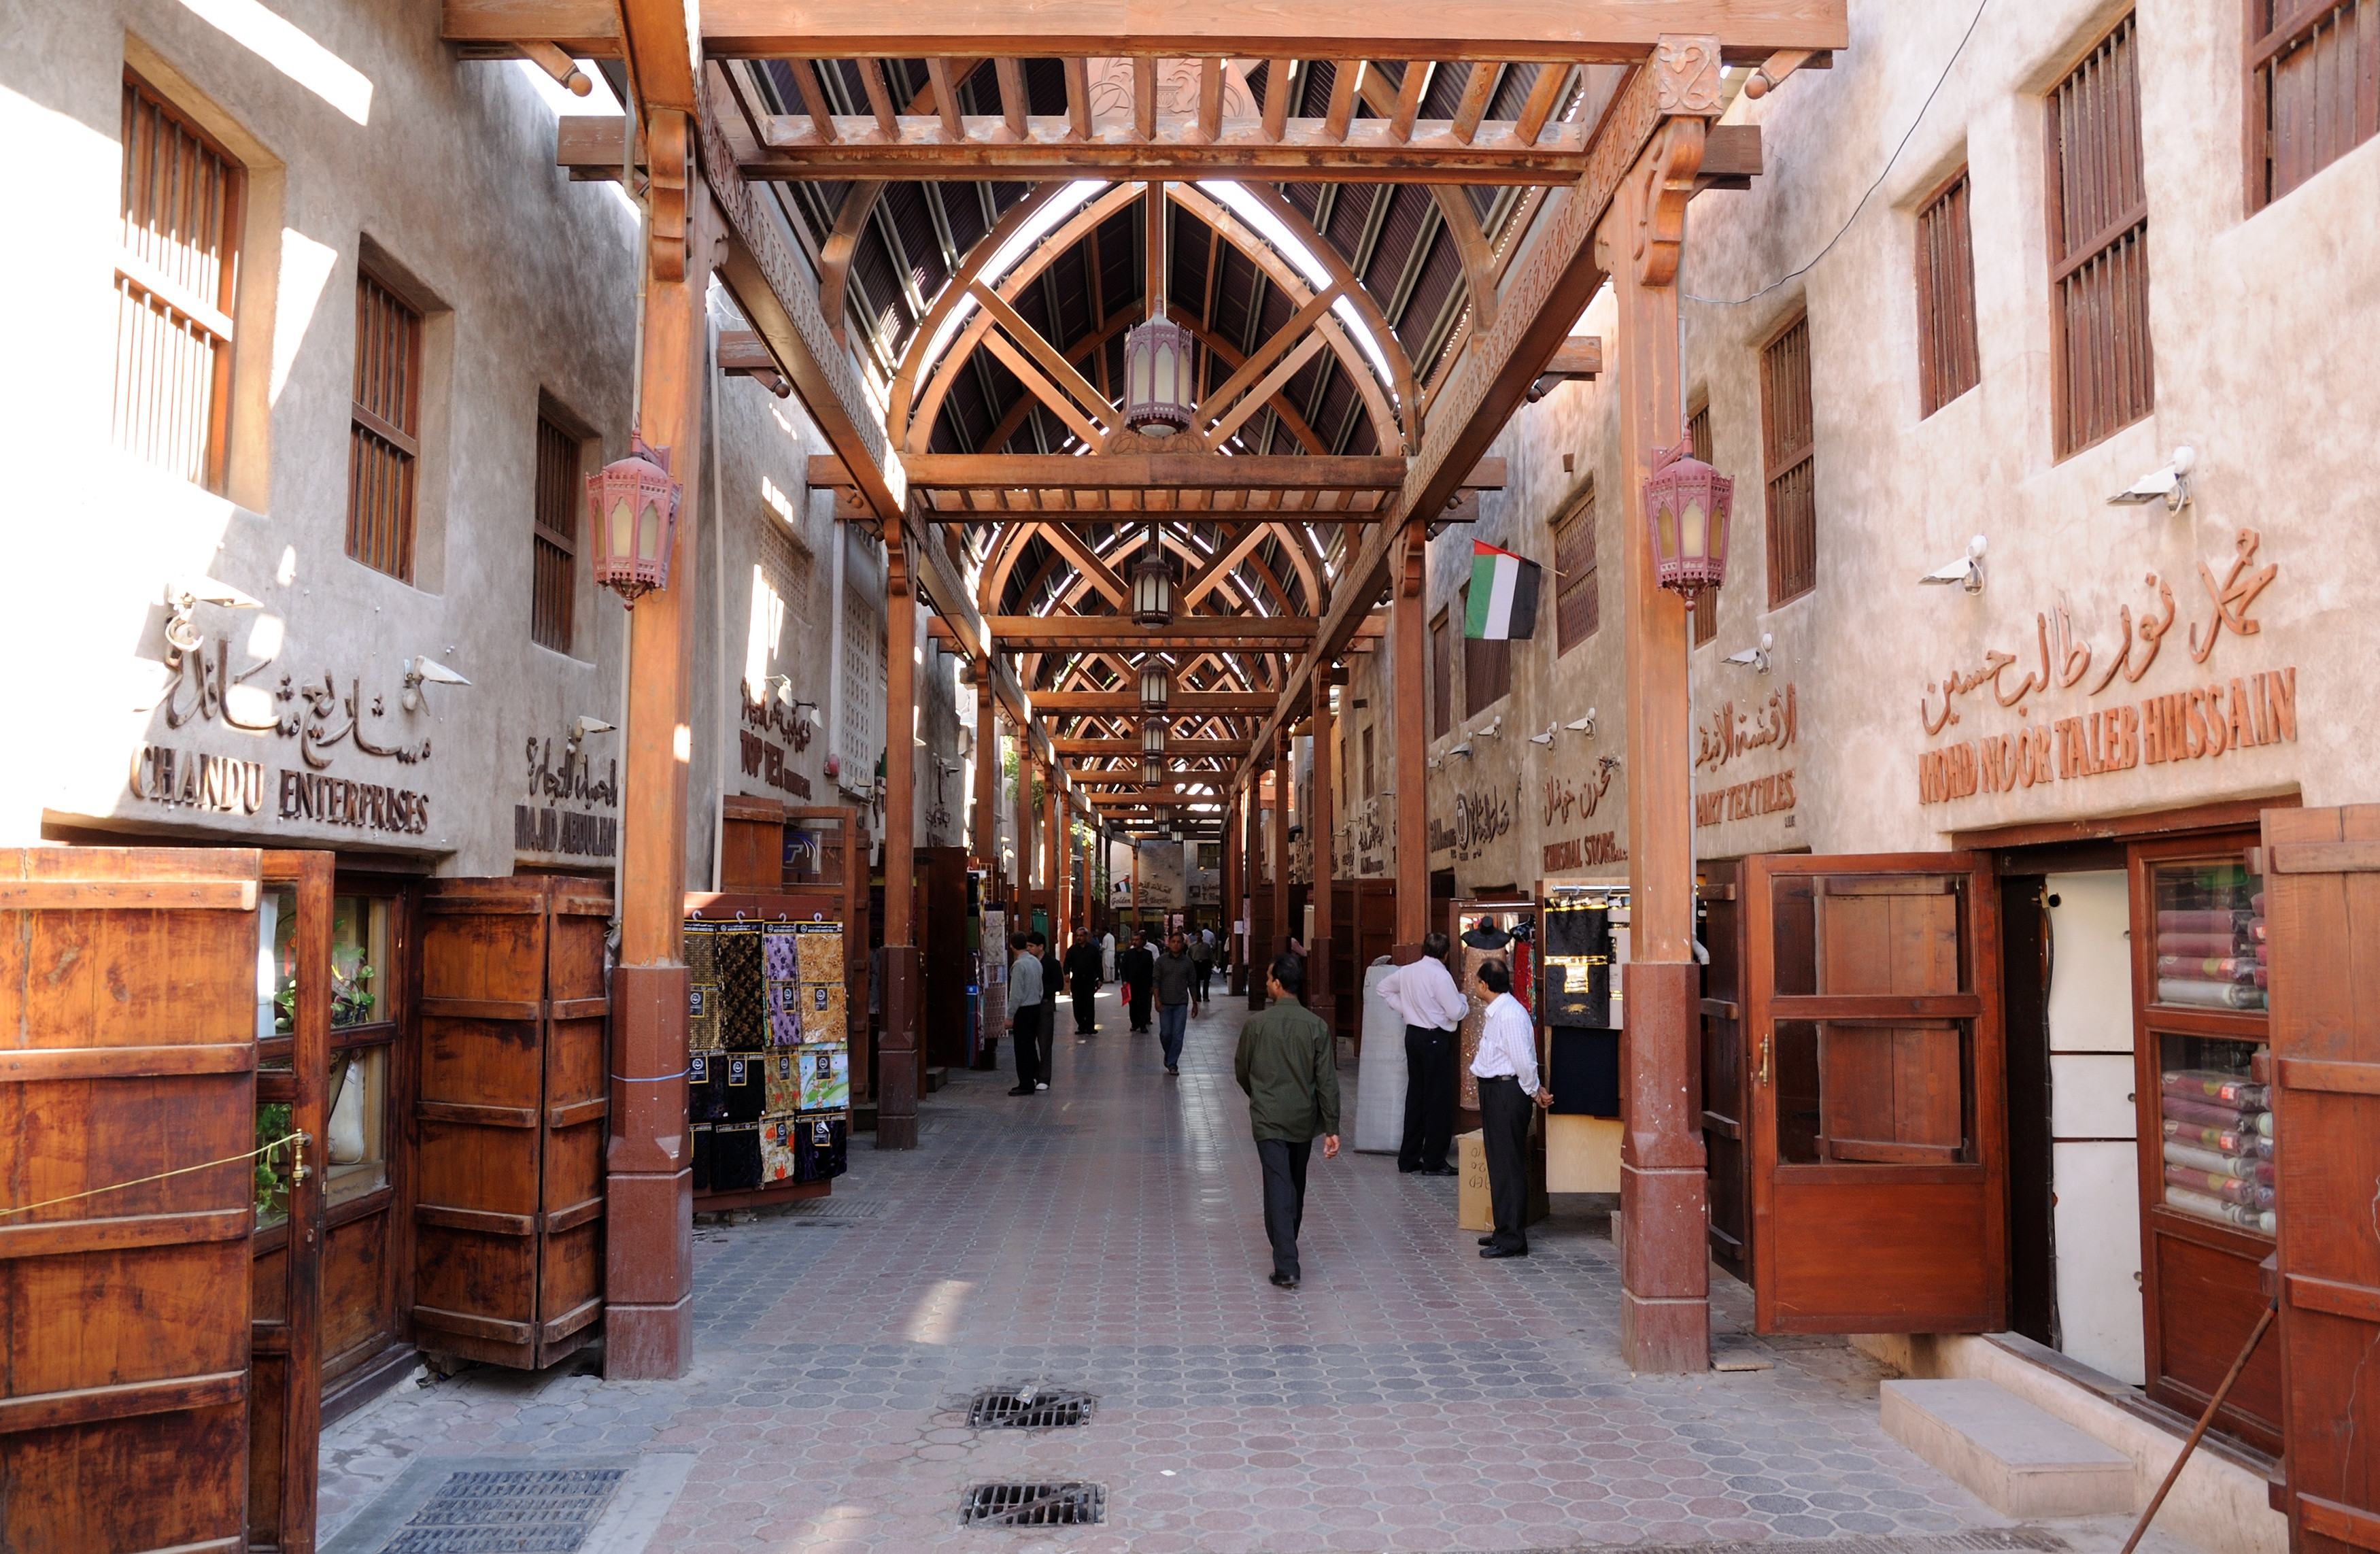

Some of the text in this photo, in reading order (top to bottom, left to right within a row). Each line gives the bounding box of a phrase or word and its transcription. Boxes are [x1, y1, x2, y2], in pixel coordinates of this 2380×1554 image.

[1993, 593, 2092, 717] طالب
[2088, 572, 2175, 696] نور
[1918, 666, 2297, 805] MOHD NOOR TALEB HUSSAIN
[1921, 649, 2017, 736] حسين
[129, 745, 430, 834] CHANDU ENTERPRISES
[739, 729, 763, 779] TOP
[764, 741, 785, 790] TEX
[1726, 769, 1797, 822] TEXTILES
[558, 811, 617, 857] ABDULHA
[1110, 896, 1132, 905] Golden
